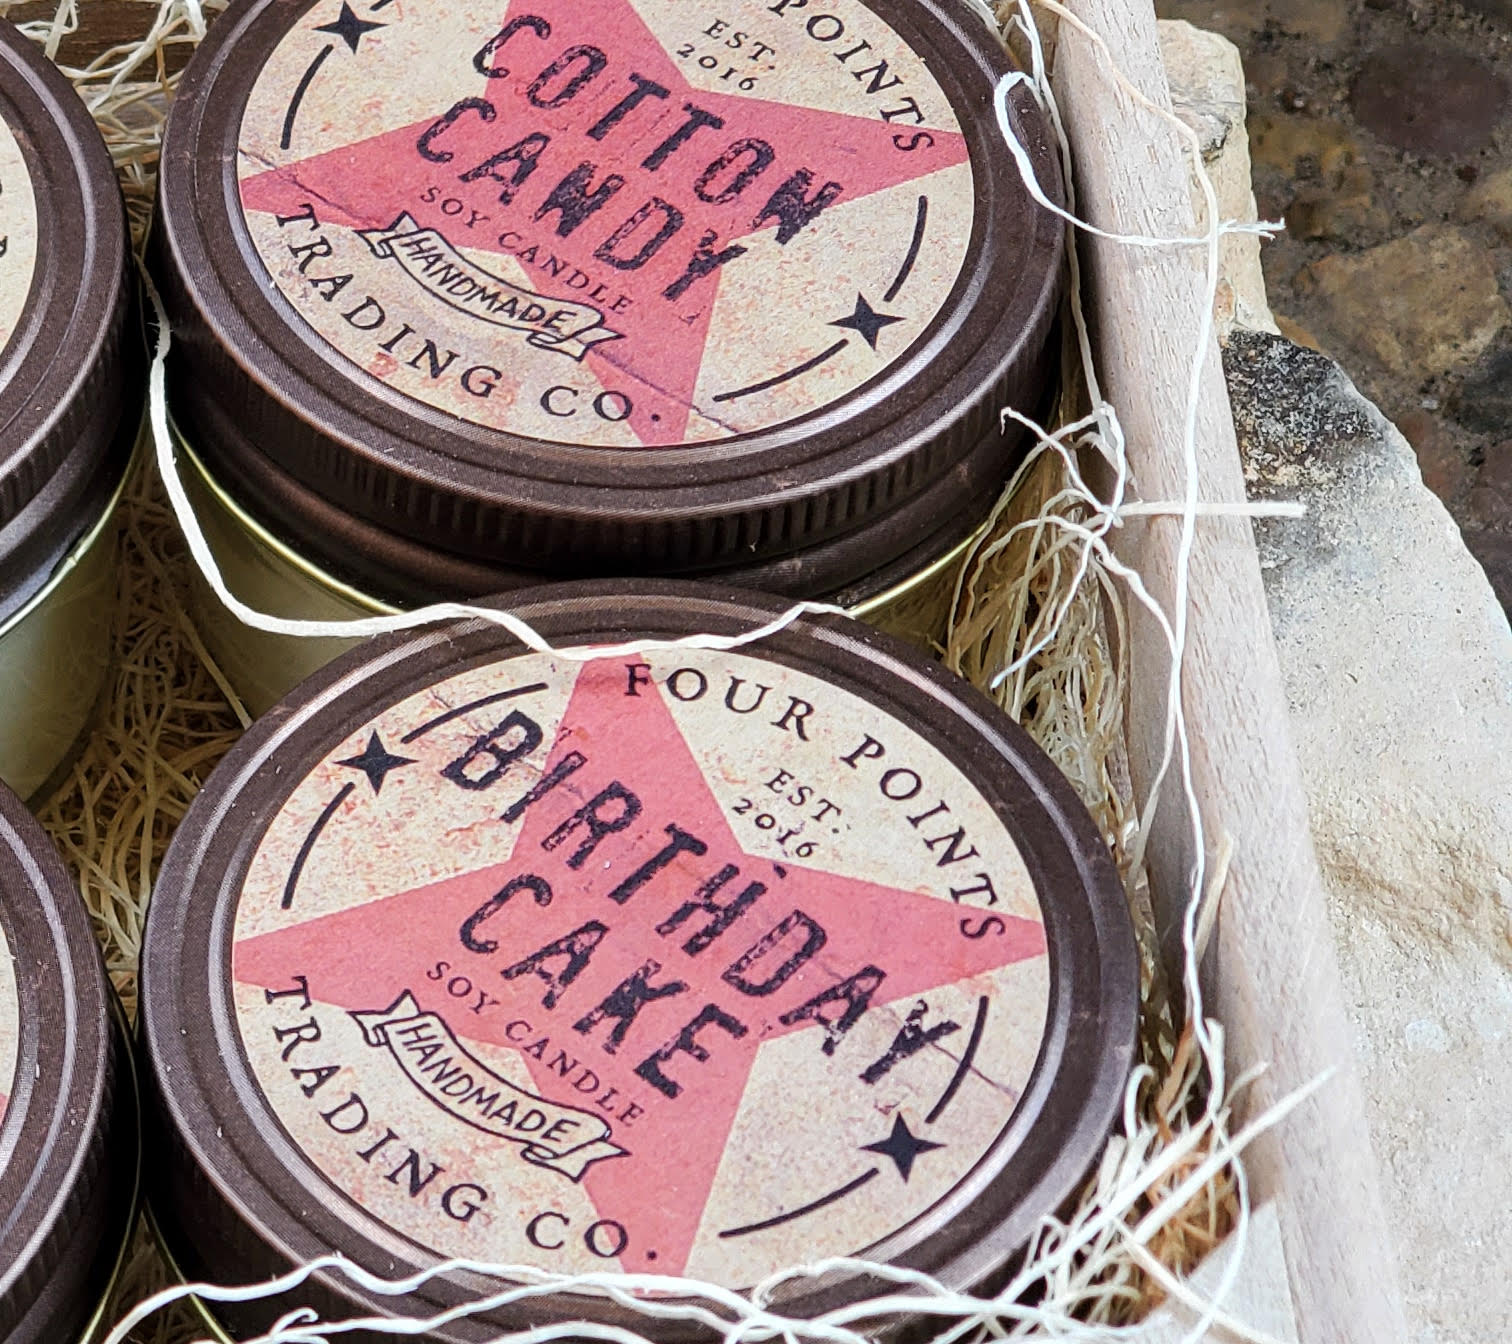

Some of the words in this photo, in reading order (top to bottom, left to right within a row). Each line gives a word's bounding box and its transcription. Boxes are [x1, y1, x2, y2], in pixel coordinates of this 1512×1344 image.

[675, 42, 758, 90] 2016
[703, 18, 776, 70] EST.
[417, 97, 748, 302] CANDY
[473, 14, 843, 245] COTTON
[277, 203, 502, 397] TRADING
[540, 388, 662, 423] CO.
[403, 230, 571, 334] HANDMADE
[418, 186, 491, 231] SOY
[498, 230, 633, 315] CANDLE
[623, 662, 814, 744] FOUR
[840, 734, 1007, 941] POINTS
[732, 797, 818, 857] 2016
[764, 769, 843, 832] EST.
[440, 710, 961, 1087] BIRTHDAY
[425, 962, 500, 1016] SOY
[503, 1020, 646, 1129] CANDLE
[459, 874, 748, 1098] CAKE
[263, 976, 492, 1225] TRADING
[525, 1209, 658, 1262] CO.
[396, 1020, 574, 1144] HANDMADE
